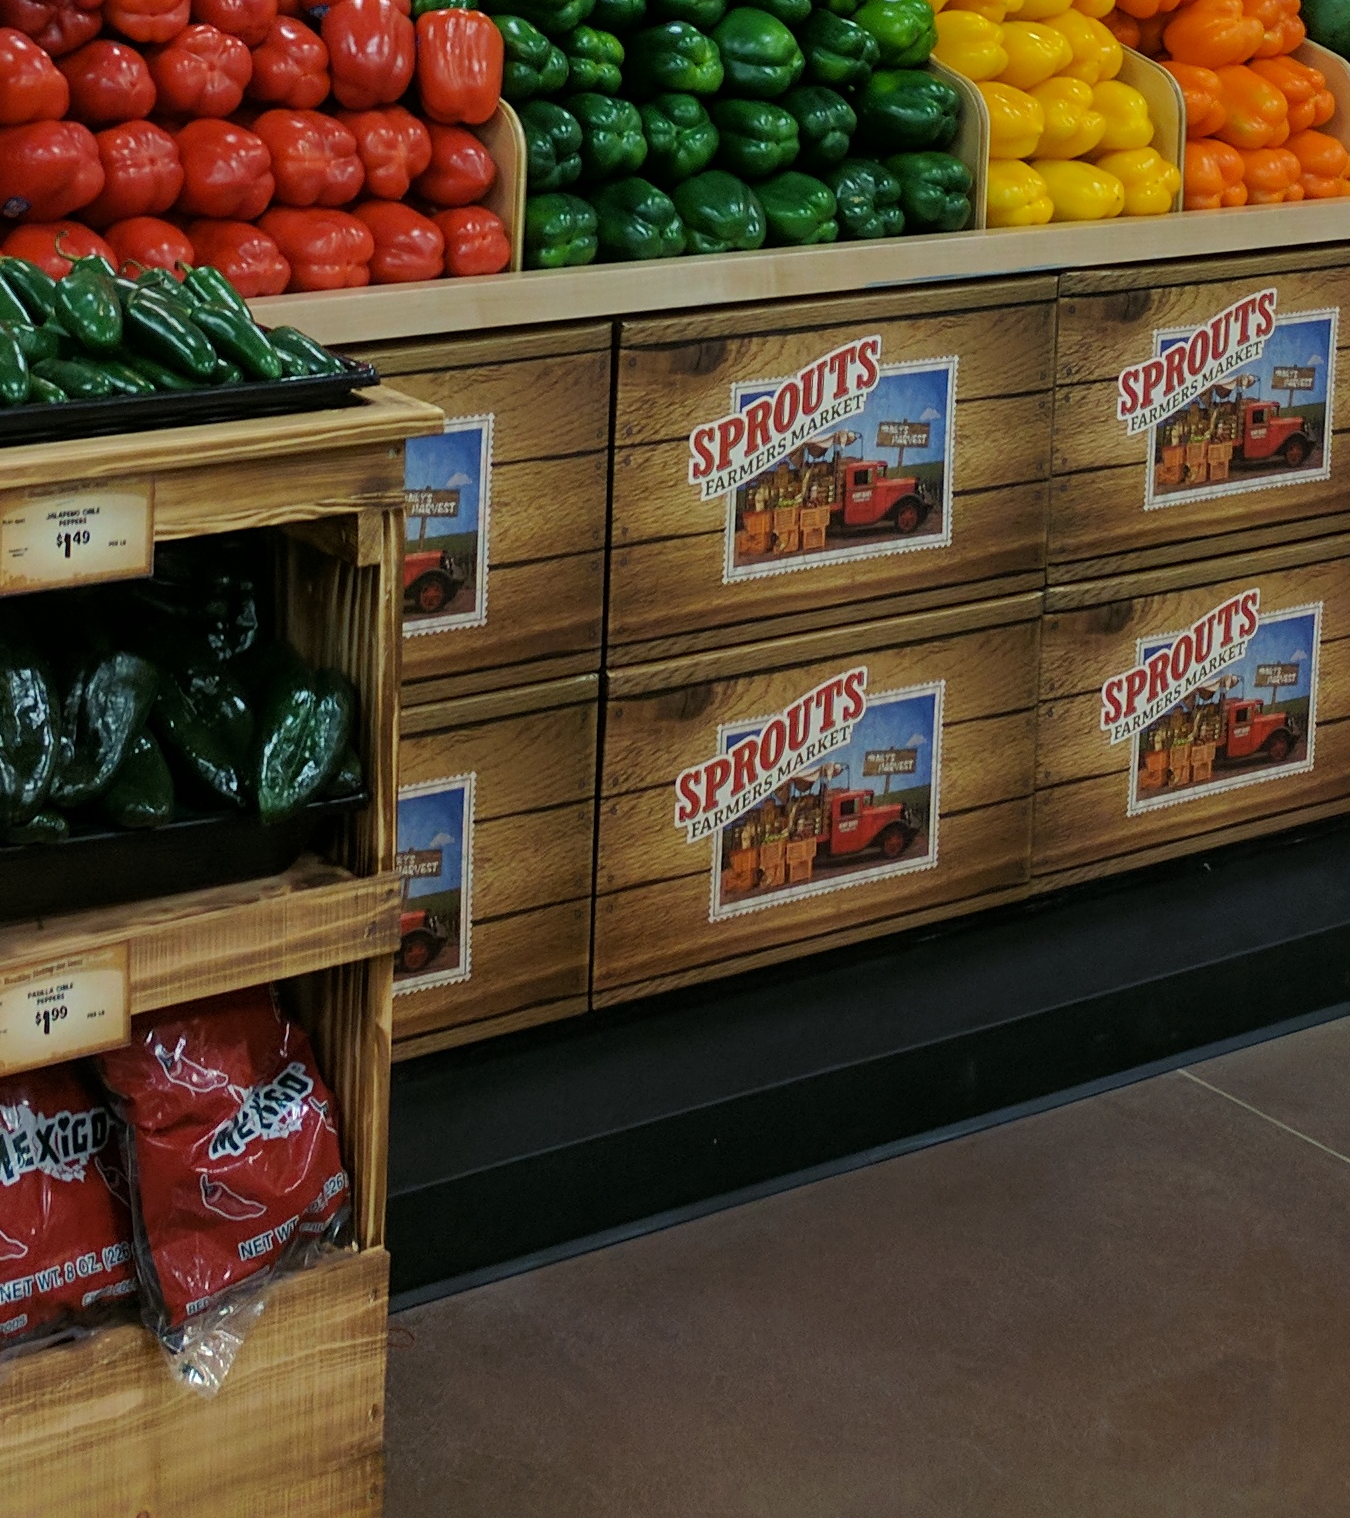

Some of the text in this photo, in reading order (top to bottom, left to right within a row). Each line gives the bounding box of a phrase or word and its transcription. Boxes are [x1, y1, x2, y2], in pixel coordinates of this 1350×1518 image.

[693, 339, 879, 479] SPROUTS
[1121, 291, 1275, 417] SPROUTS
[1131, 341, 1263, 432] FARMERS MARKET
[704, 393, 866, 497] FARMERS MARKET
[1104, 592, 1258, 725] SPROUTS
[1113, 640, 1246, 741] FARMERS MARKET
[679, 670, 865, 823] SPROUTS
[691, 724, 851, 840] FARMERS MARKET
[65, 1267, 75, 1283] 8
[239, 1218, 300, 1261] NET WT
